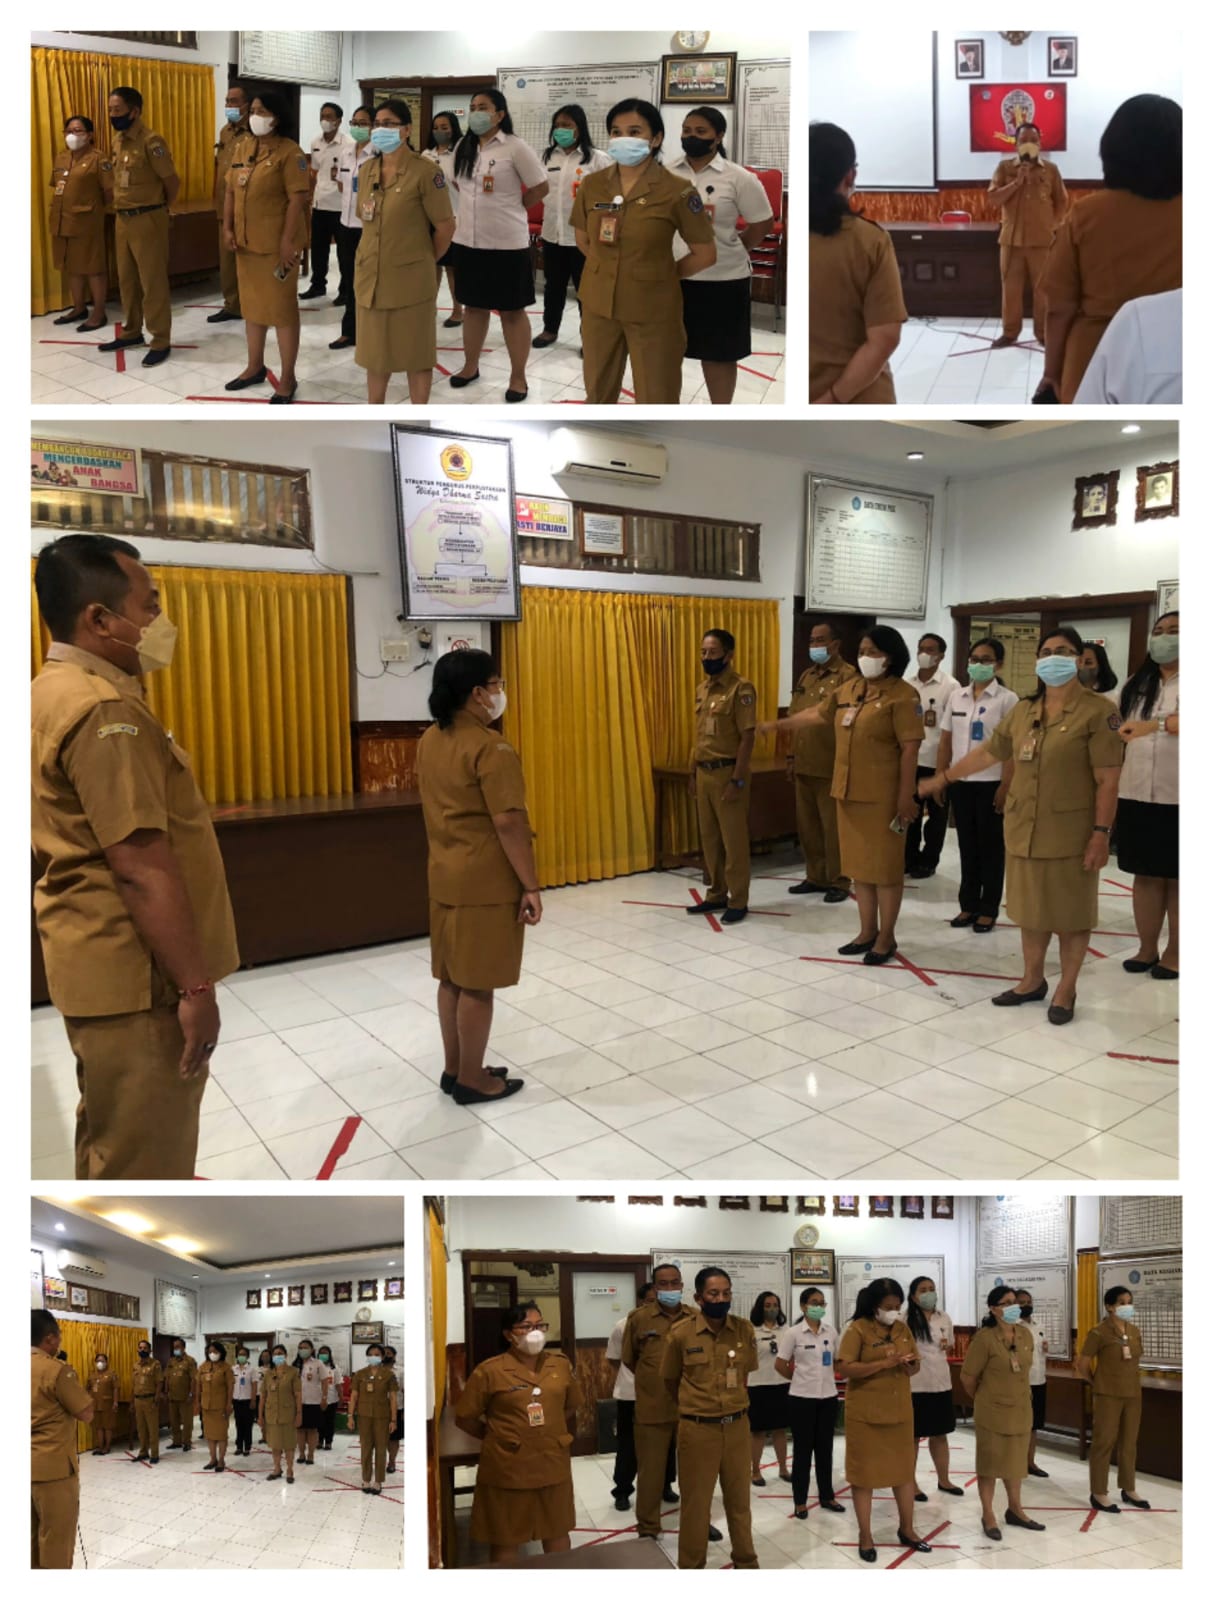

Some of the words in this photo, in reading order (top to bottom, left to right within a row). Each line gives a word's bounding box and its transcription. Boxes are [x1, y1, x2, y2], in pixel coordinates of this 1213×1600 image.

[44, 453, 122, 469] MENCERDASKAN
[73, 466, 102, 477] ANAK
[91, 479, 133, 489] BANGSA
[517, 521, 533, 530] ASTI
[536, 522, 567, 533] BERJAYA
